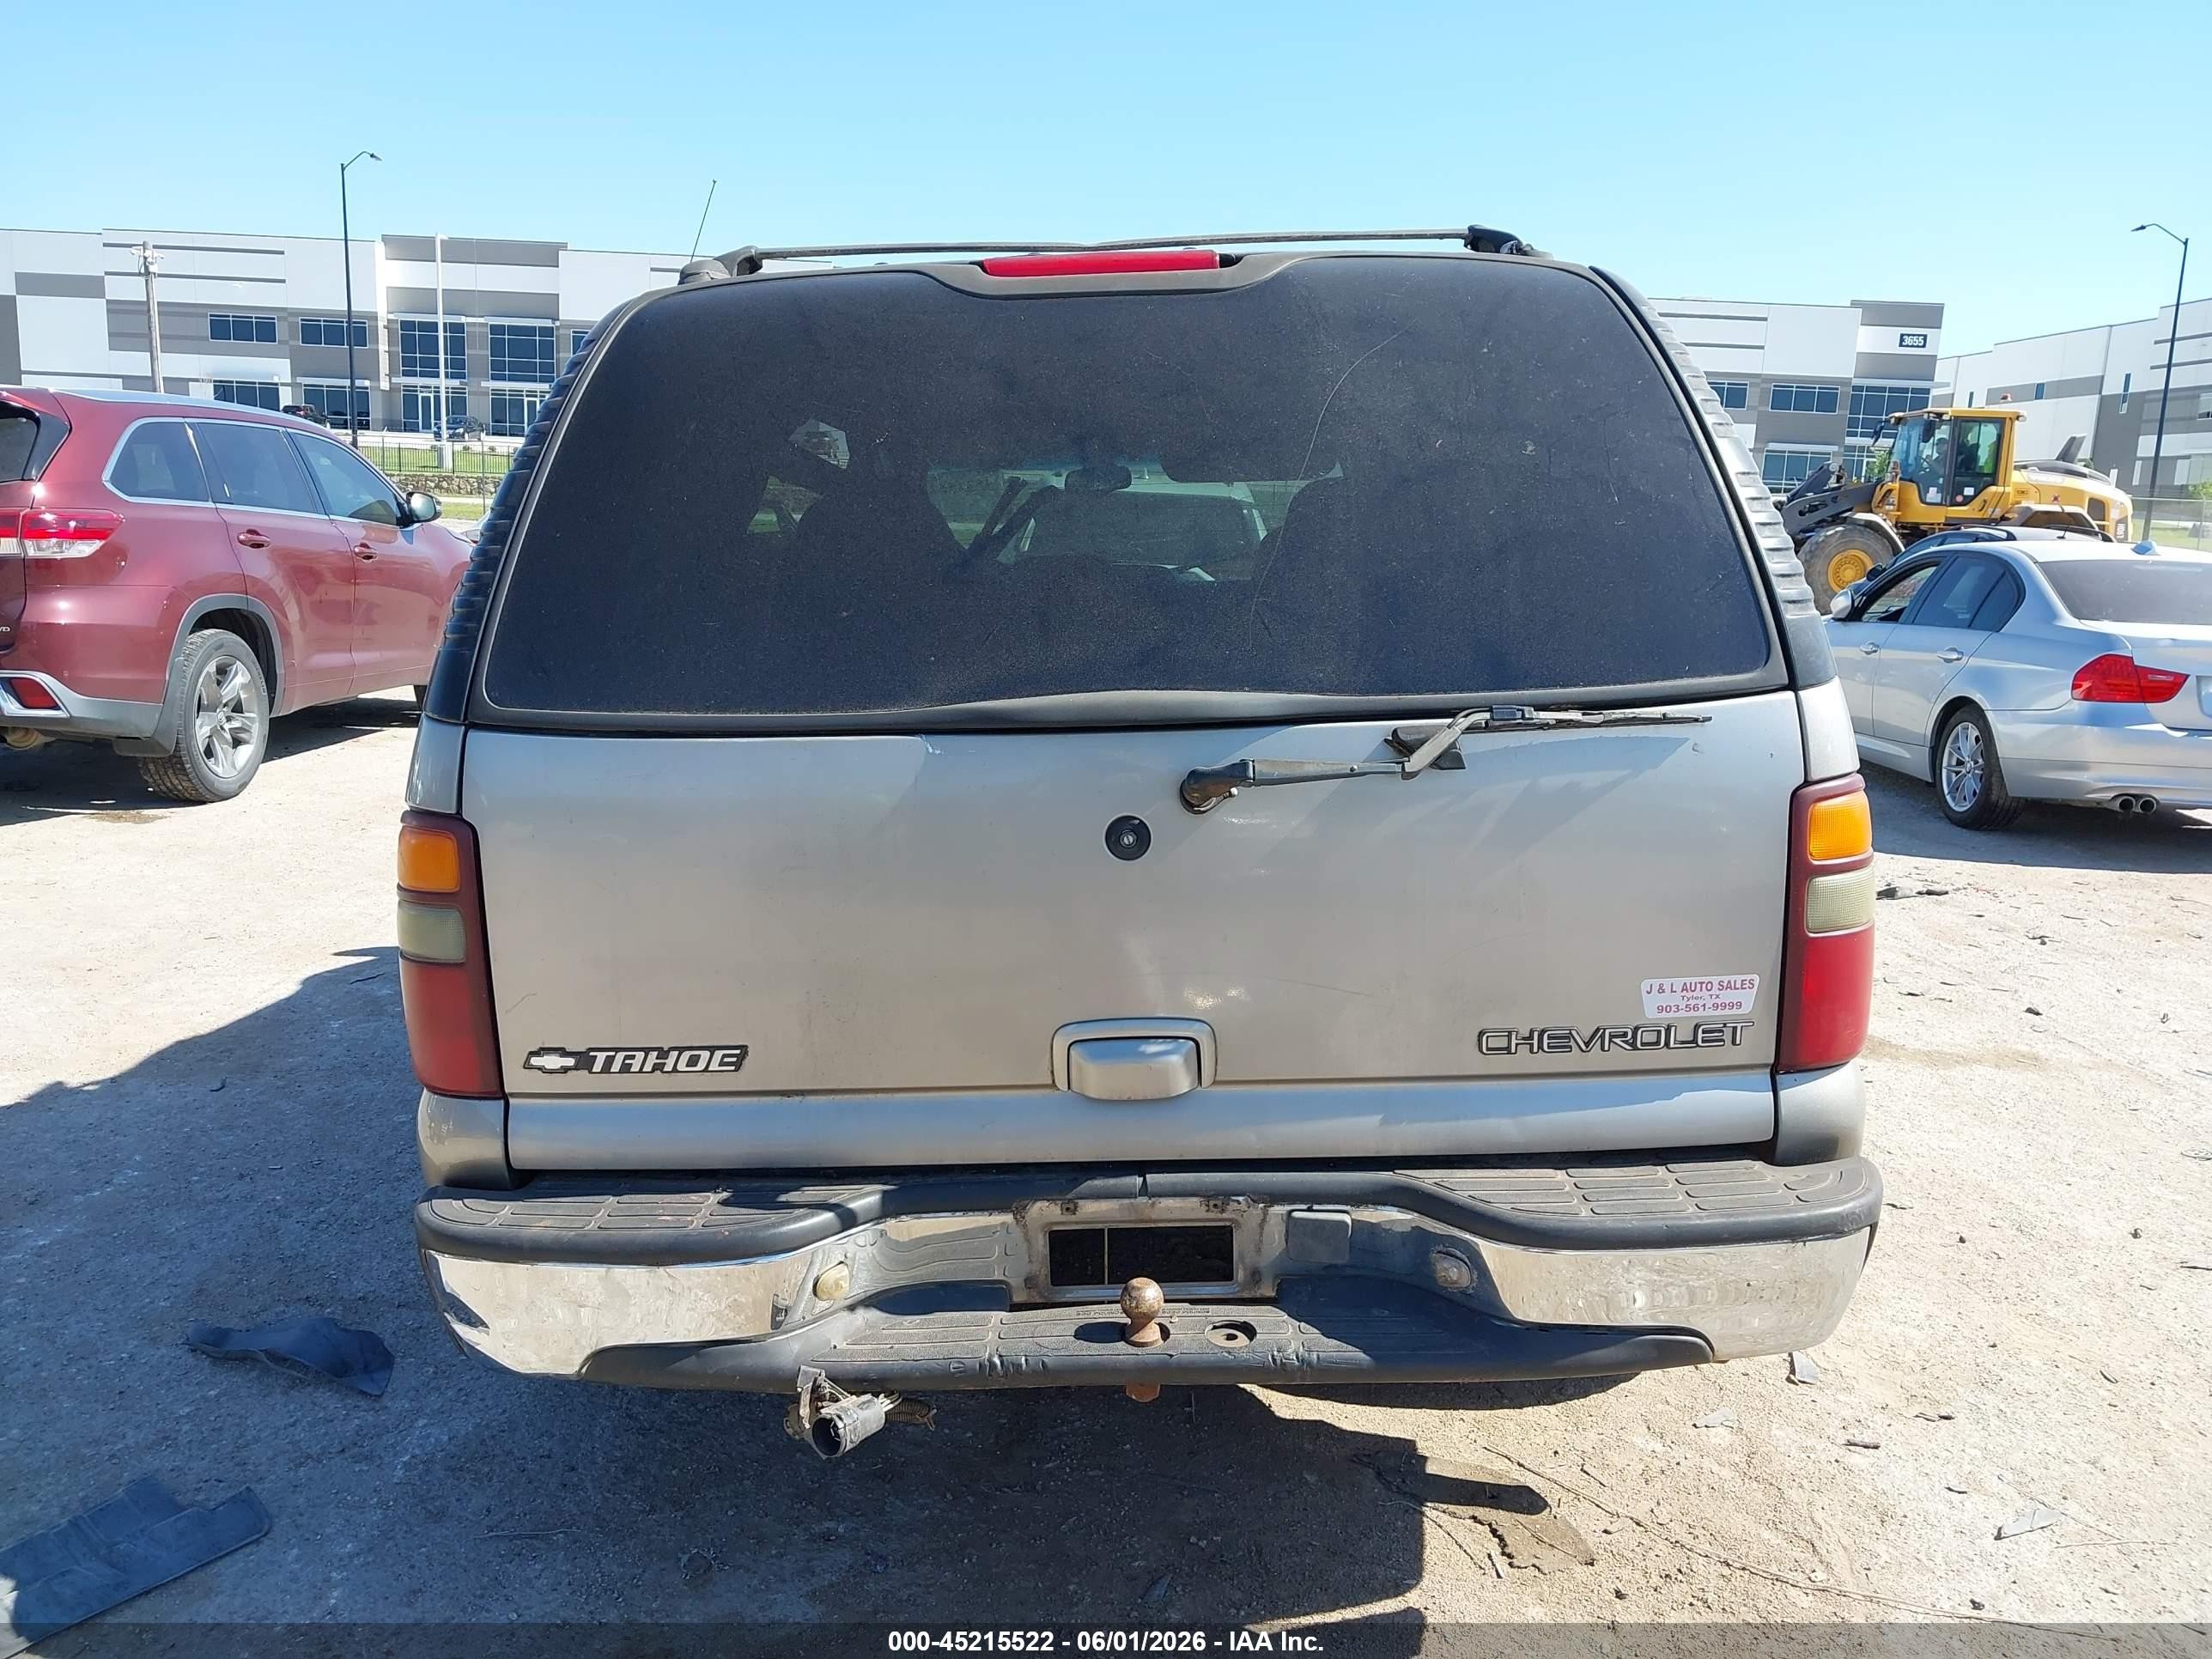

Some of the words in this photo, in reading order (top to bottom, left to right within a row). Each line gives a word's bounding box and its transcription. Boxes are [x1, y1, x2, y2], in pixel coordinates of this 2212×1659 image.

[1902, 336, 1924, 346] 3655
[1646, 983, 1652, 994] J
[1657, 983, 1665, 994] &
[1670, 982, 1676, 993] L
[1680, 981, 1713, 993] AUTO
[1717, 979, 1754, 991] SALES
[1656, 1001, 1742, 1013] 903-561-9999
[1479, 1020, 1754, 1055] CHEVROLET
[589, 1049, 741, 1073] TAHOE
